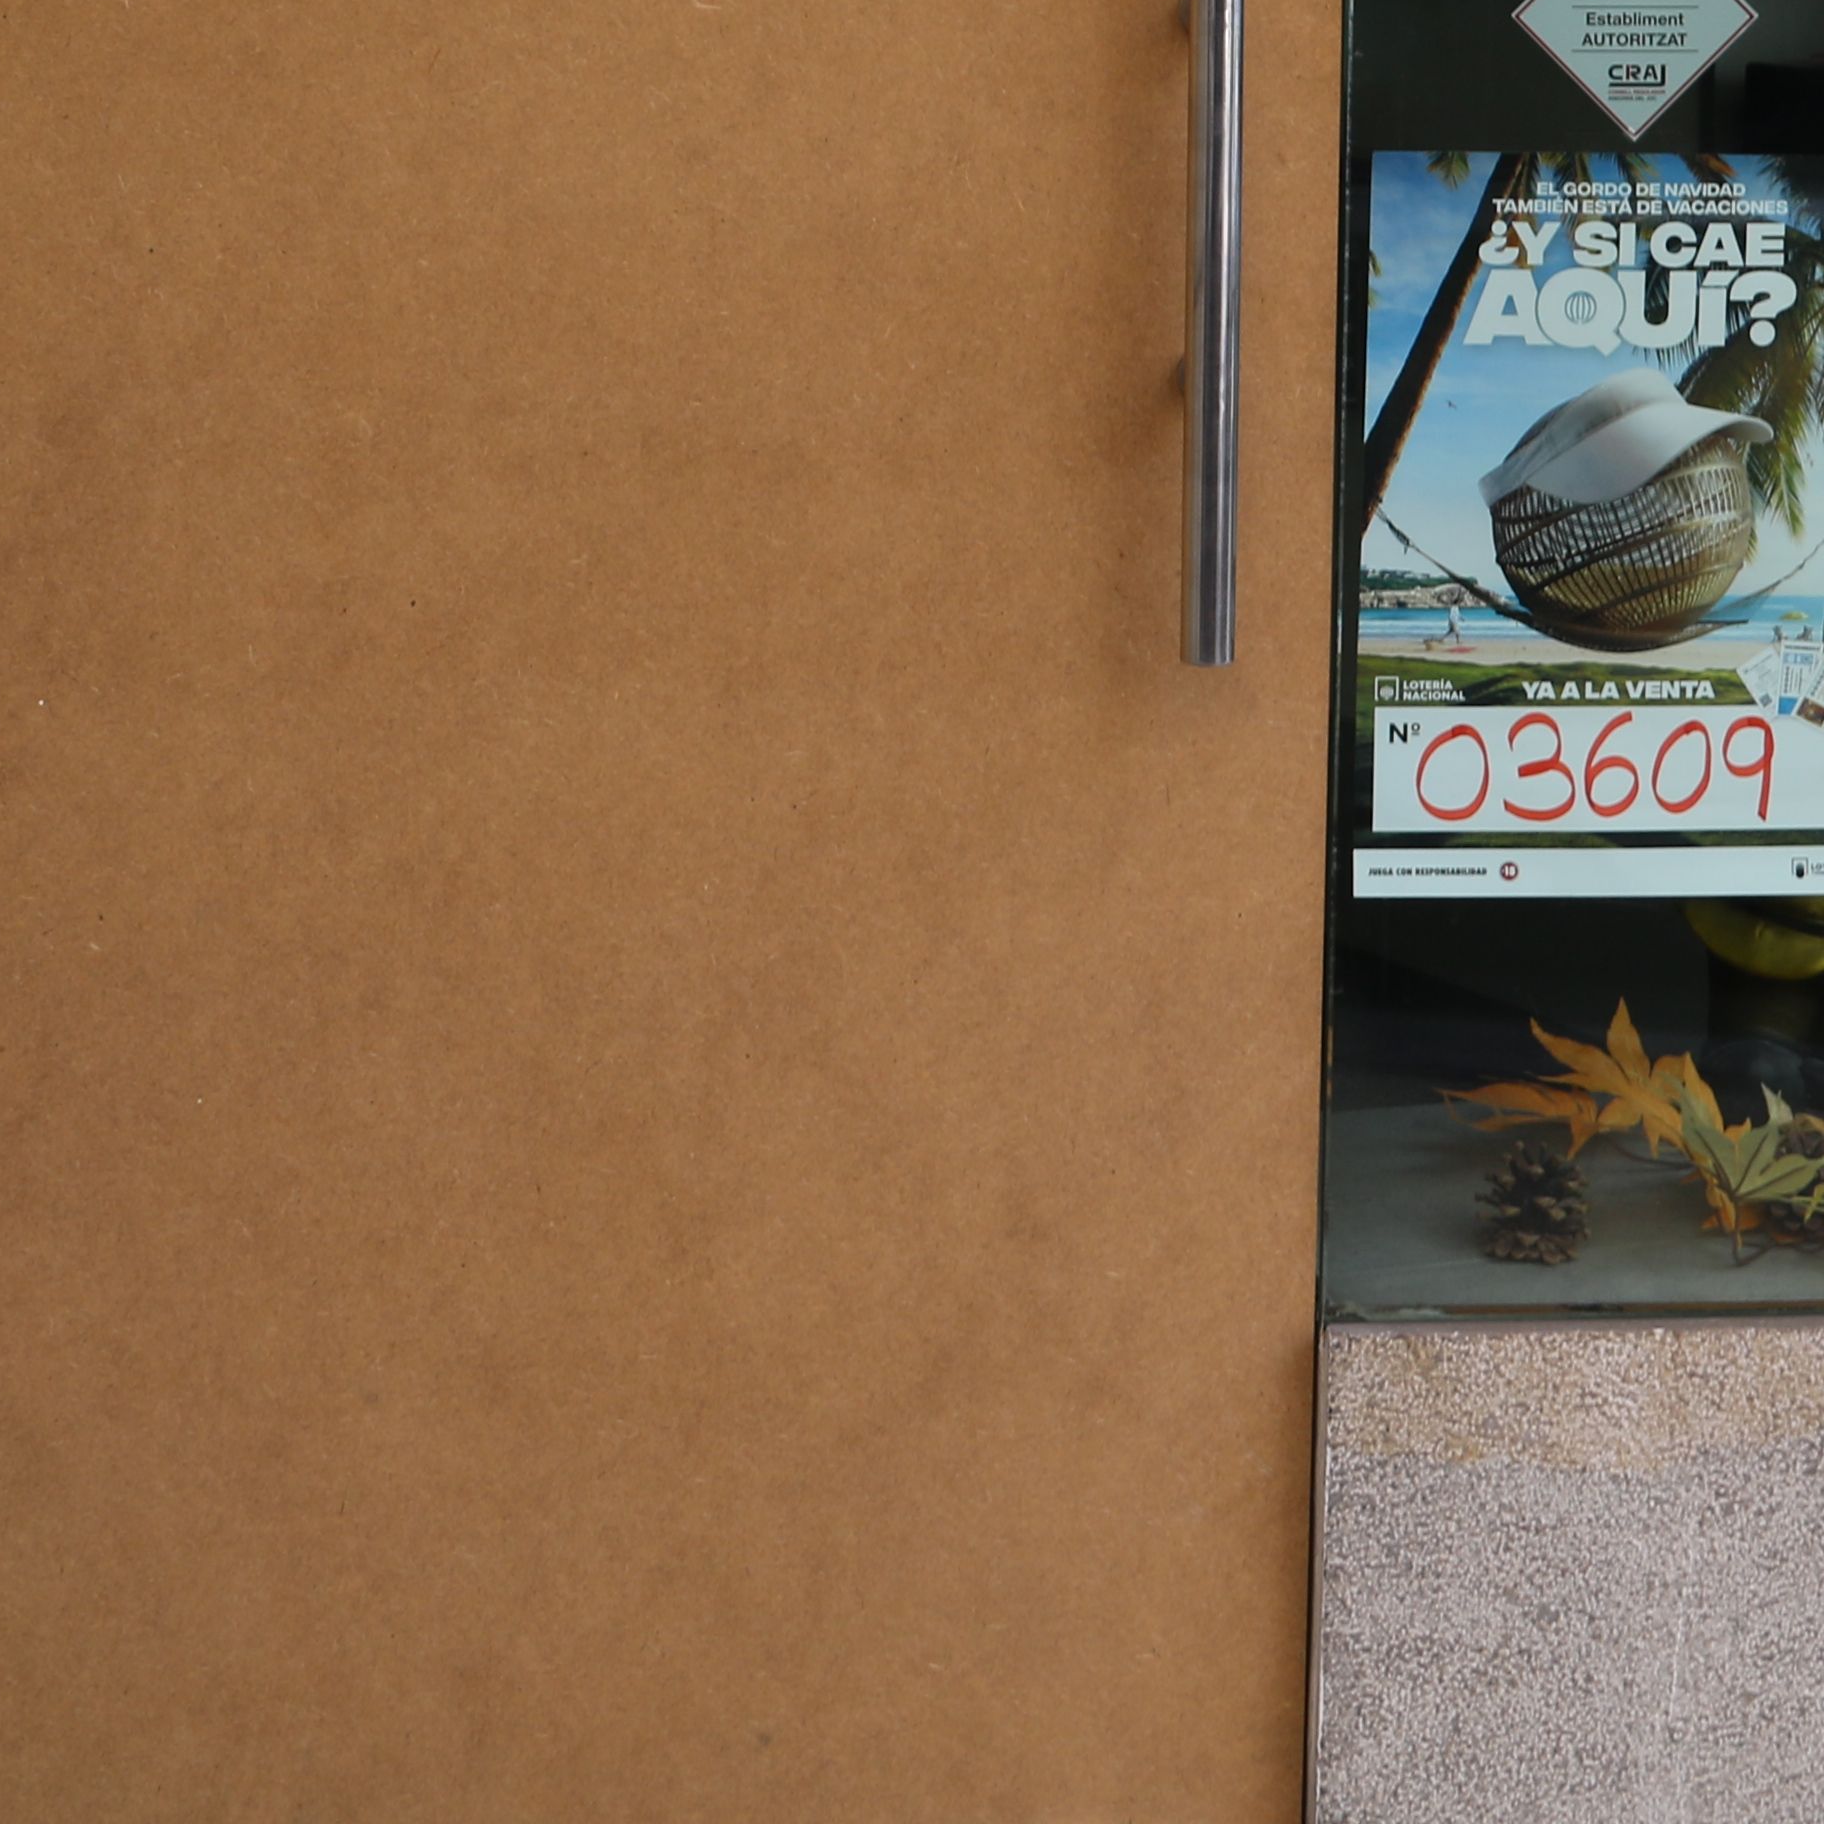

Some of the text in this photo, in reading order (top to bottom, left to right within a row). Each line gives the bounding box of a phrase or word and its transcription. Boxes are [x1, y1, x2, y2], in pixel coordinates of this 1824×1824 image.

[1586, 12, 1685, 26] Establiment
[1582, 33, 1687, 47] AUTORITZAT
[1607, 63, 1666, 87] CRAJ
[1536, 182, 1746, 198] EL GORDO DE NAVIDAD
[1492, 195, 1789, 215] TAMBIÉN ESTÁ DE VACACIONES
[1478, 220, 1786, 268] ¿Y SI CAE
[1463, 267, 1798, 357] AQUÍ?
[1402, 678, 1453, 691] LOTERÍA
[1521, 680, 1715, 701] YA A LA VENTA
[1402, 690, 1466, 702] NACIONAL
[1388, 722, 1421, 744] Nº
[1415, 710, 1775, 822] 03609
[1368, 867, 1393, 876] JUEGA
[1396, 867, 1413, 876] CON
[1415, 867, 1488, 876] RESPONSABILIDAD
